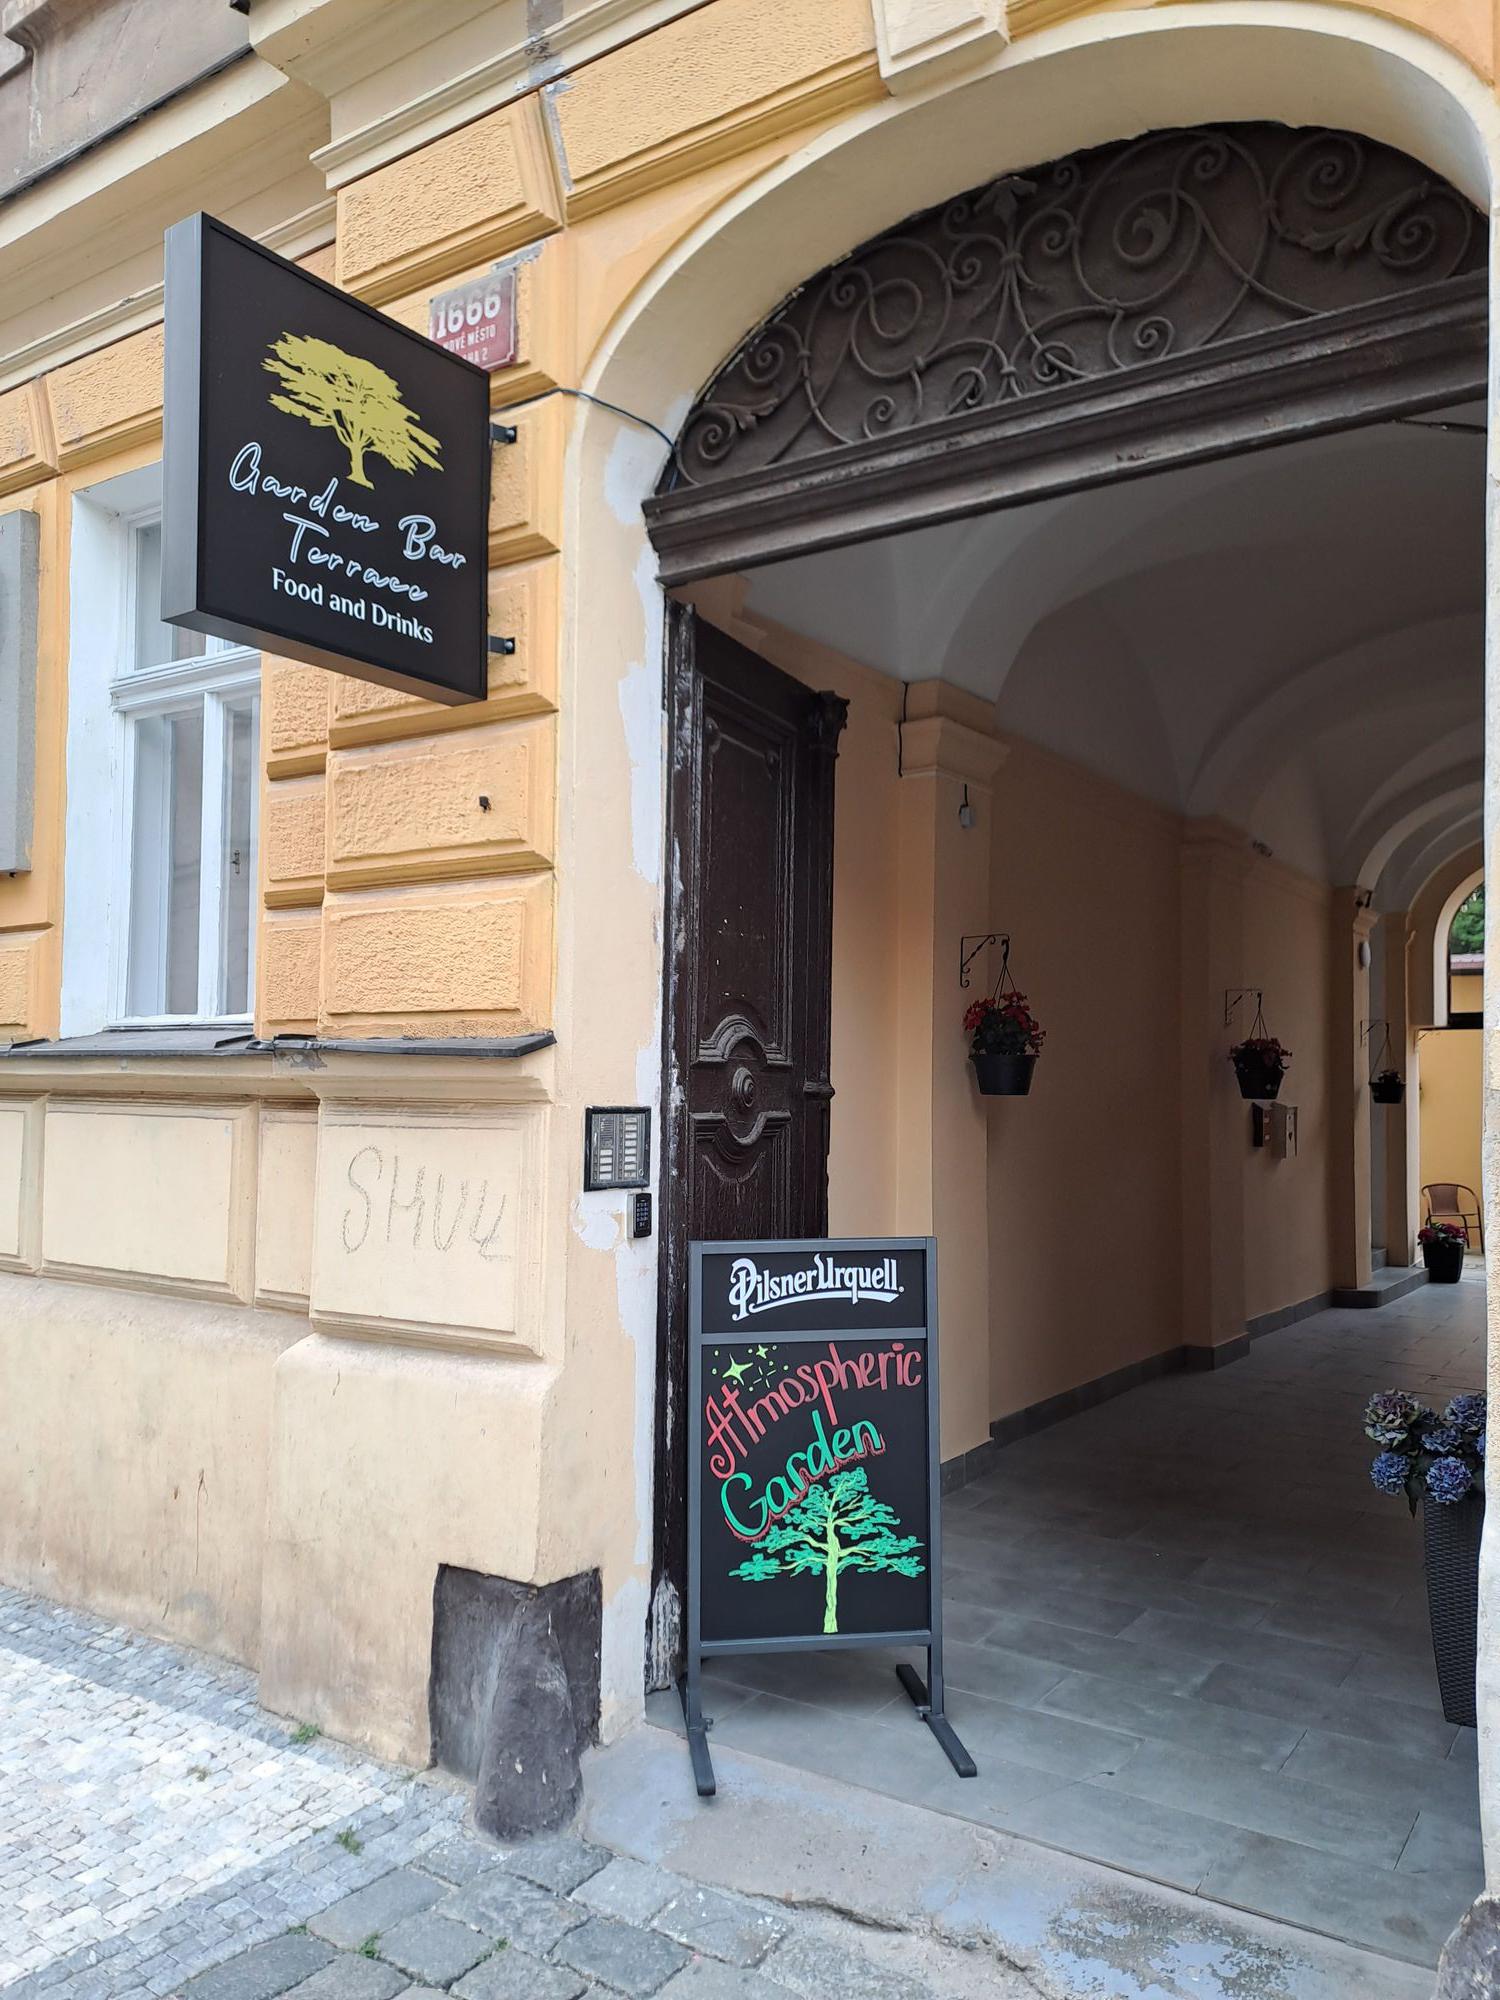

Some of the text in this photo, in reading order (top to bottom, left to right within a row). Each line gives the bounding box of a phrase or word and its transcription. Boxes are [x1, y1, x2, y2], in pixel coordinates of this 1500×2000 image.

[437, 285, 501, 338] 1666
[467, 324, 496, 346] MĚSTO
[229, 442, 466, 569] Garden Bar
[283, 513, 428, 601] Terrace
[272, 567, 433, 643] Food and Drinks
[728, 1253, 898, 1321] Pilsner Urquell
[705, 1342, 921, 1479] Atmospheric
[720, 1409, 883, 1539] Garden
